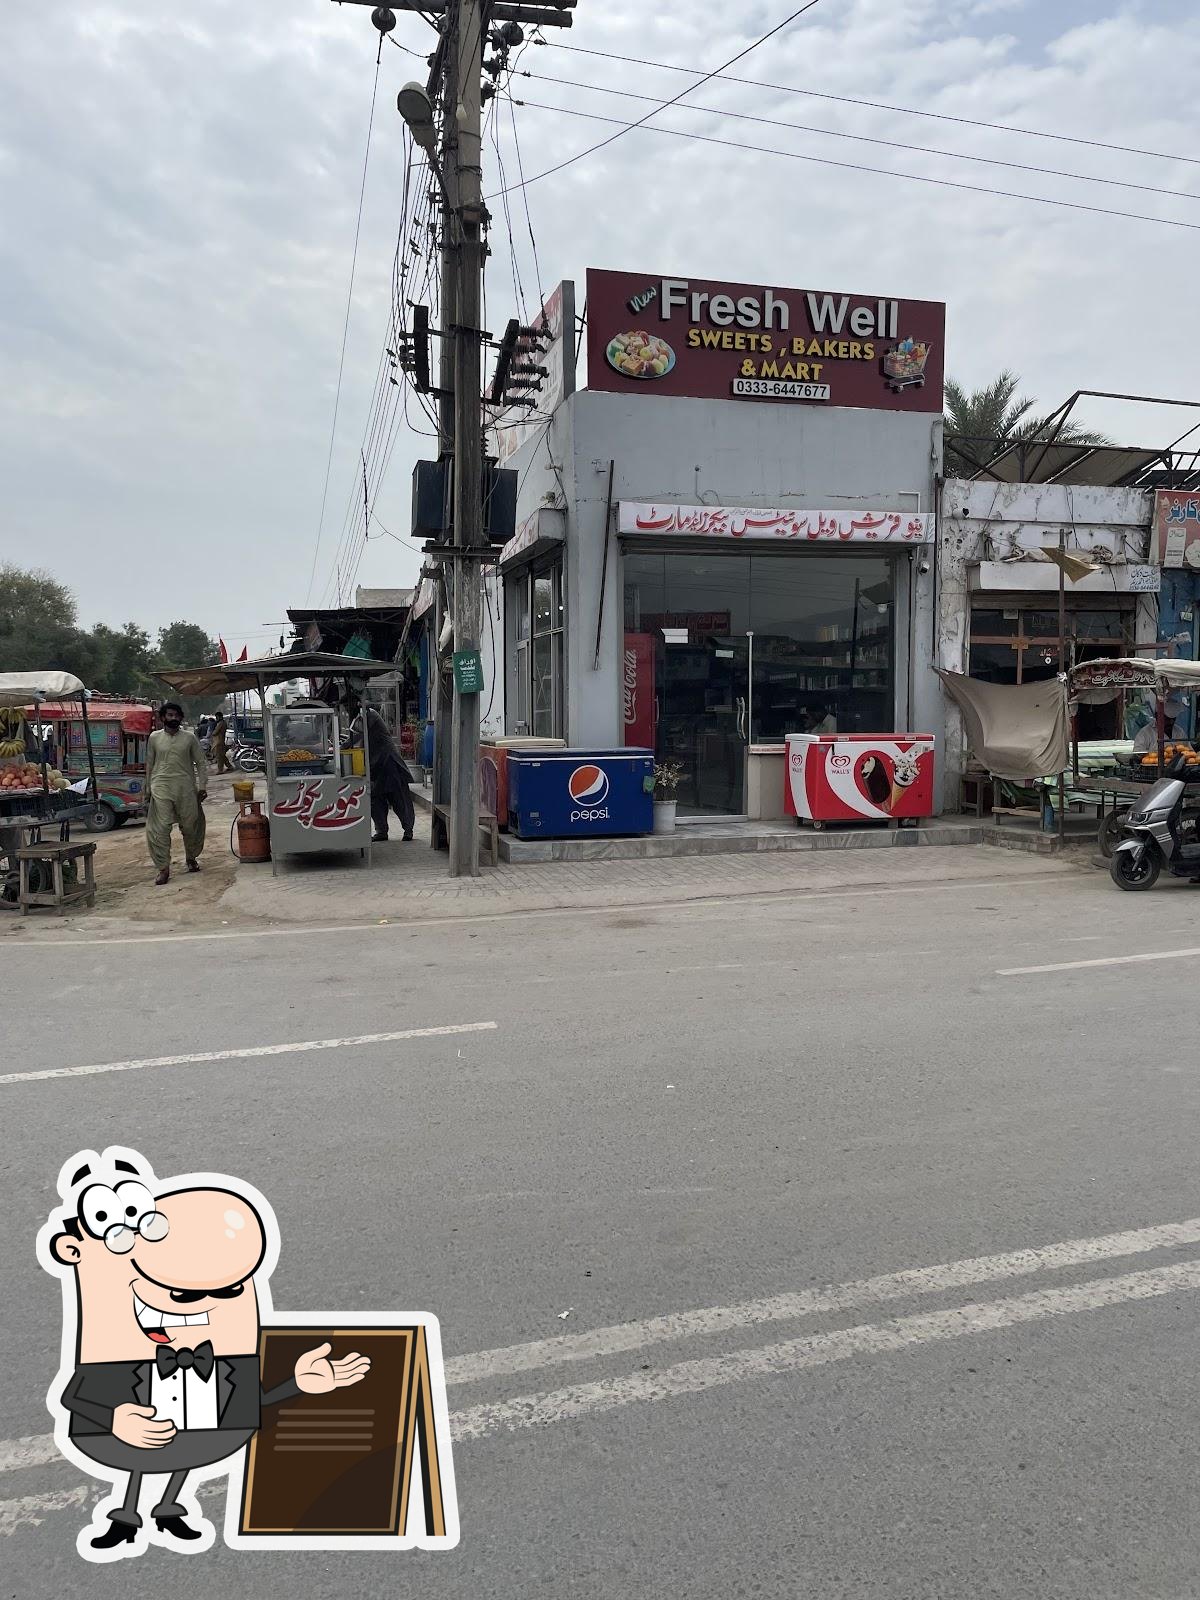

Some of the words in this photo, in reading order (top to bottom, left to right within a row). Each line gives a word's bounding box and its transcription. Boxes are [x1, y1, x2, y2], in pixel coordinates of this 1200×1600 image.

[630, 286, 657, 312] New
[661, 279, 790, 330] Fresh
[806, 293, 899, 338] Well
[688, 329, 773, 352] SWEETS
[792, 338, 875, 360] BAKERS
[741, 359, 757, 377] &
[760, 361, 823, 381] MART
[736, 380, 827, 398] 0333-6447677
[570, 806, 609, 823] pepsi
